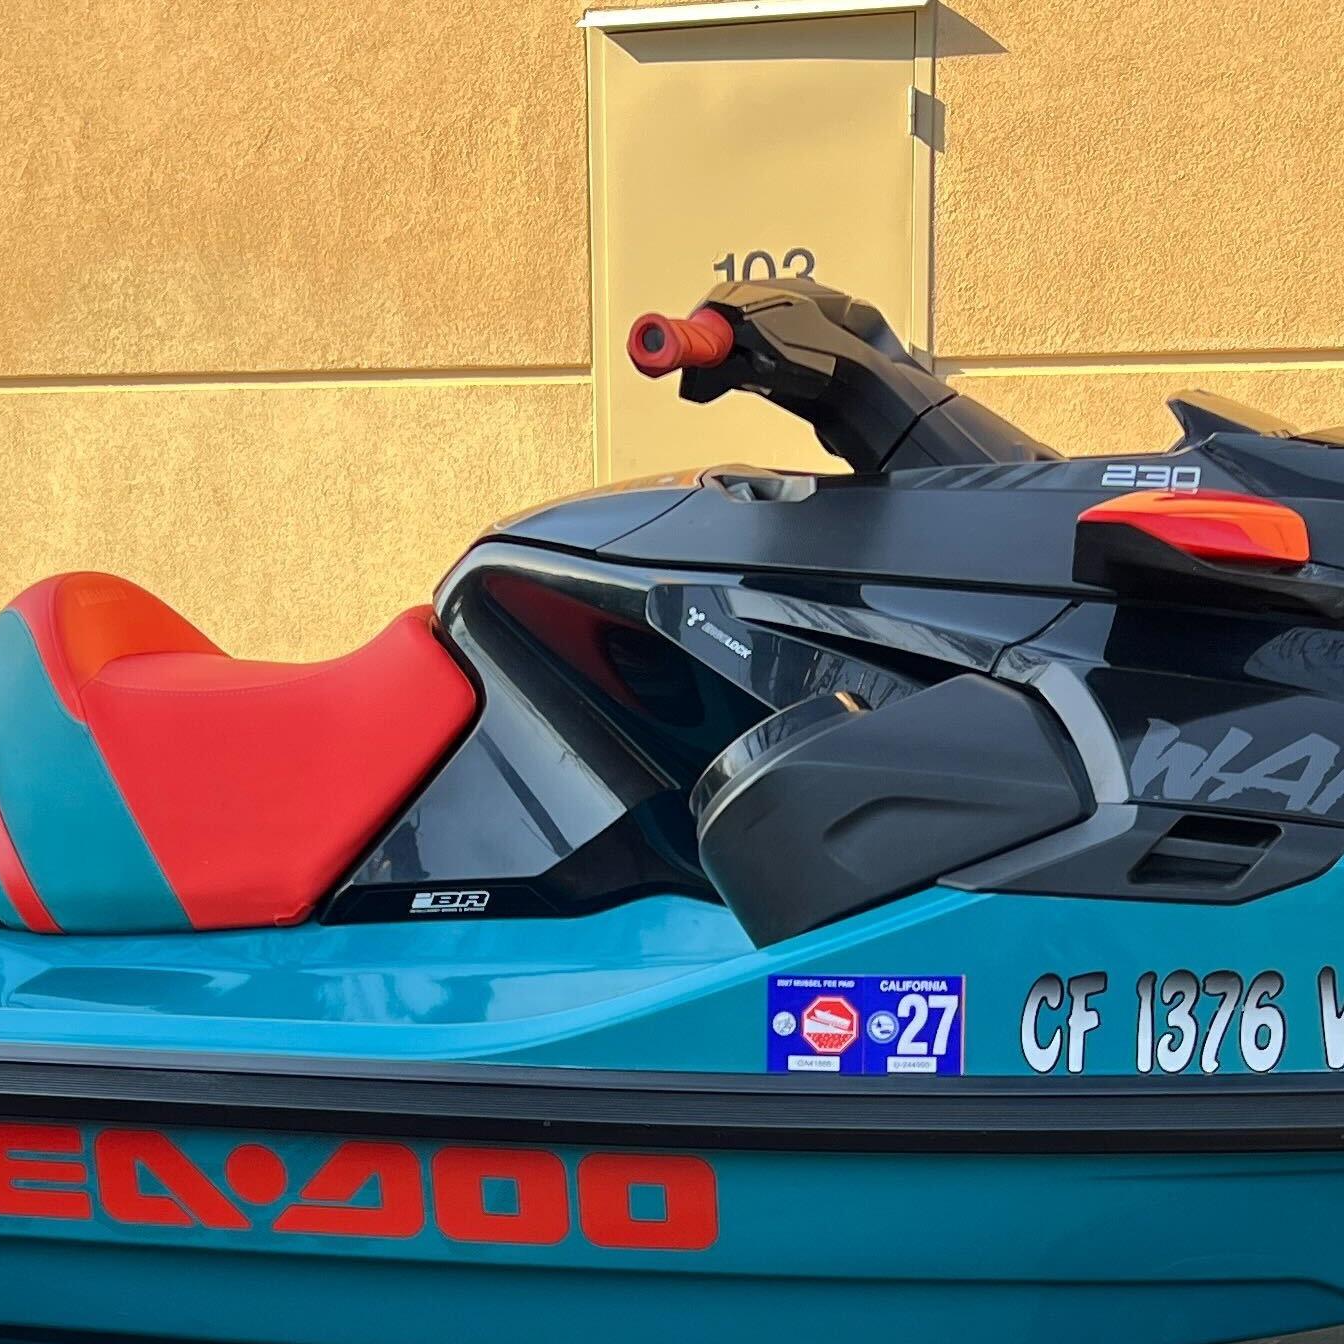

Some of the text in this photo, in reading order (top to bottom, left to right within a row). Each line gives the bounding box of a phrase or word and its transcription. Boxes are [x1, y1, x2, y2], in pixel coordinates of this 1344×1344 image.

[1101, 464, 1201, 489] 230
[879, 980, 948, 992] CALIFORNIA
[896, 993, 959, 1056] 27
[1020, 971, 1108, 1074] CF
[1135, 969, 1286, 1074] 1376
